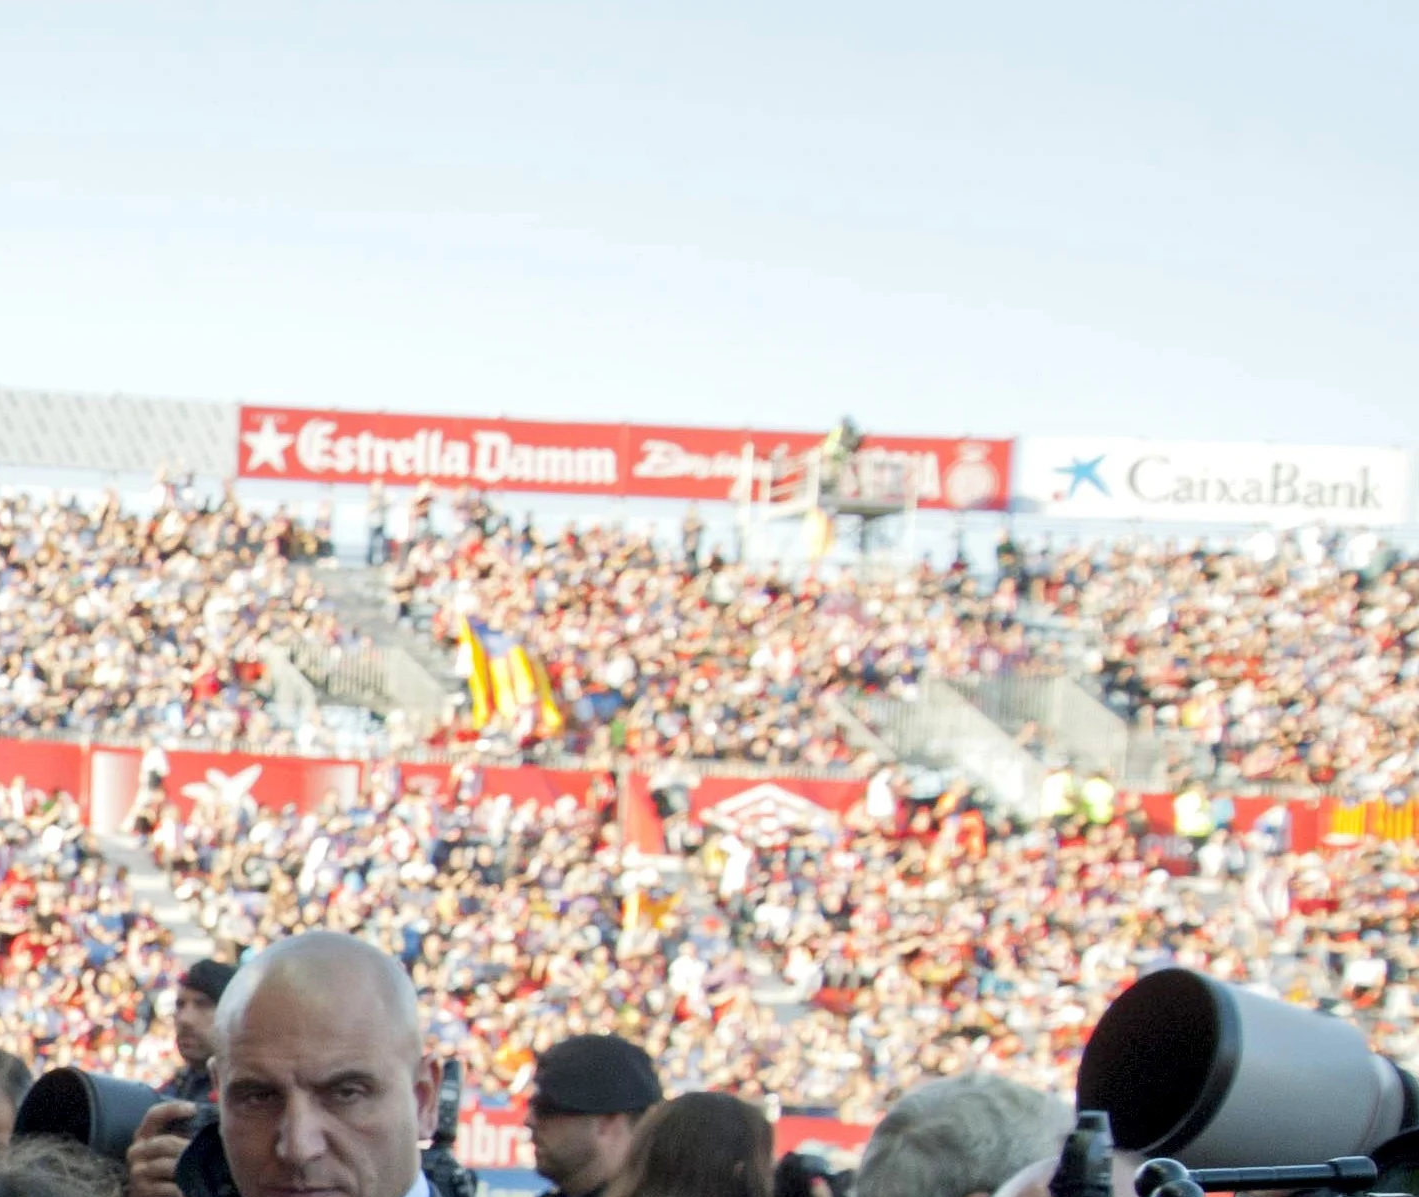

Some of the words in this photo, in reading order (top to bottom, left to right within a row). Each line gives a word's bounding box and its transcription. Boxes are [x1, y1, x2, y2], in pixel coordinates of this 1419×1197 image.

[296, 417, 470, 476] Estrella
[474, 429, 618, 484] Damm
[1126, 454, 1383, 509] CaixaBank
